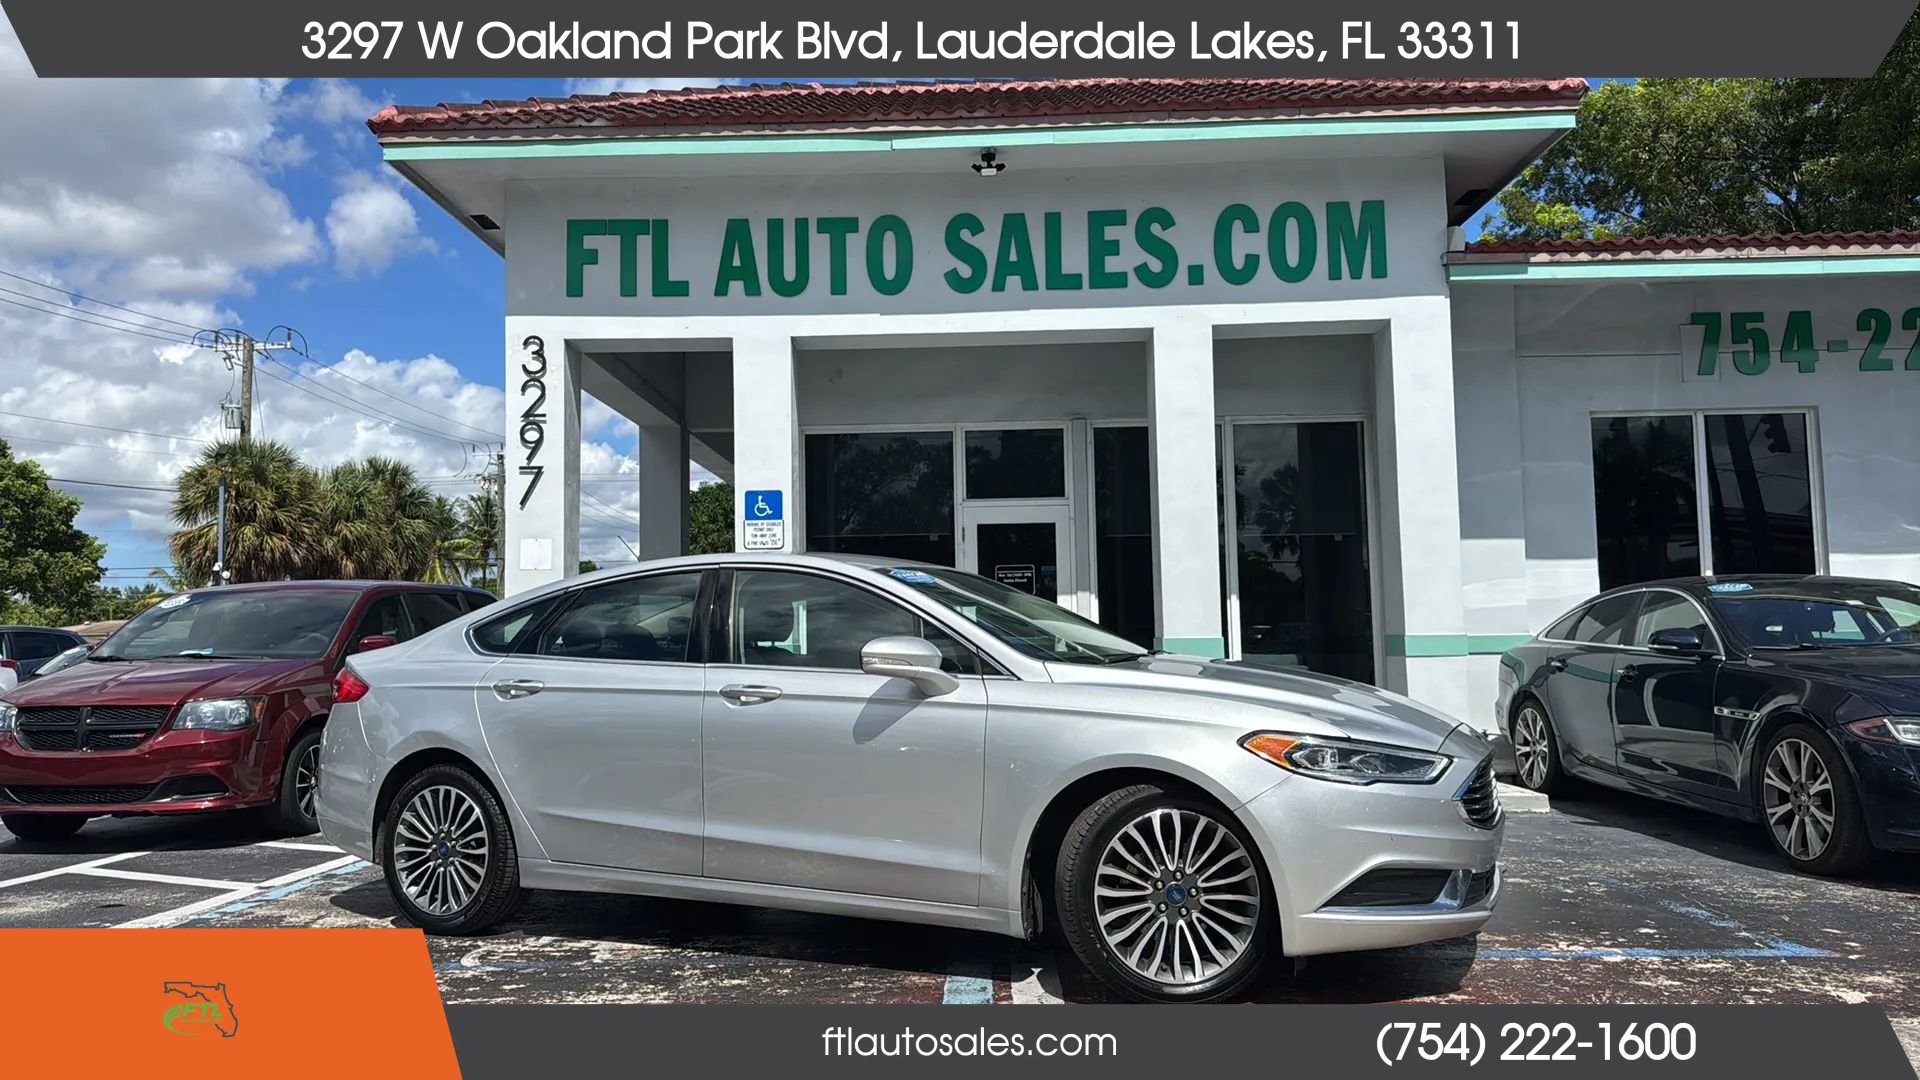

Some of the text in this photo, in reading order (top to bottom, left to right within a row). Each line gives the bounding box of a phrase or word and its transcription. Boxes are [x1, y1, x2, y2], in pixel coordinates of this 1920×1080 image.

[565, 200, 1388, 299] FTL AUTO SALES.COM
[518, 334, 547, 510] 3297
